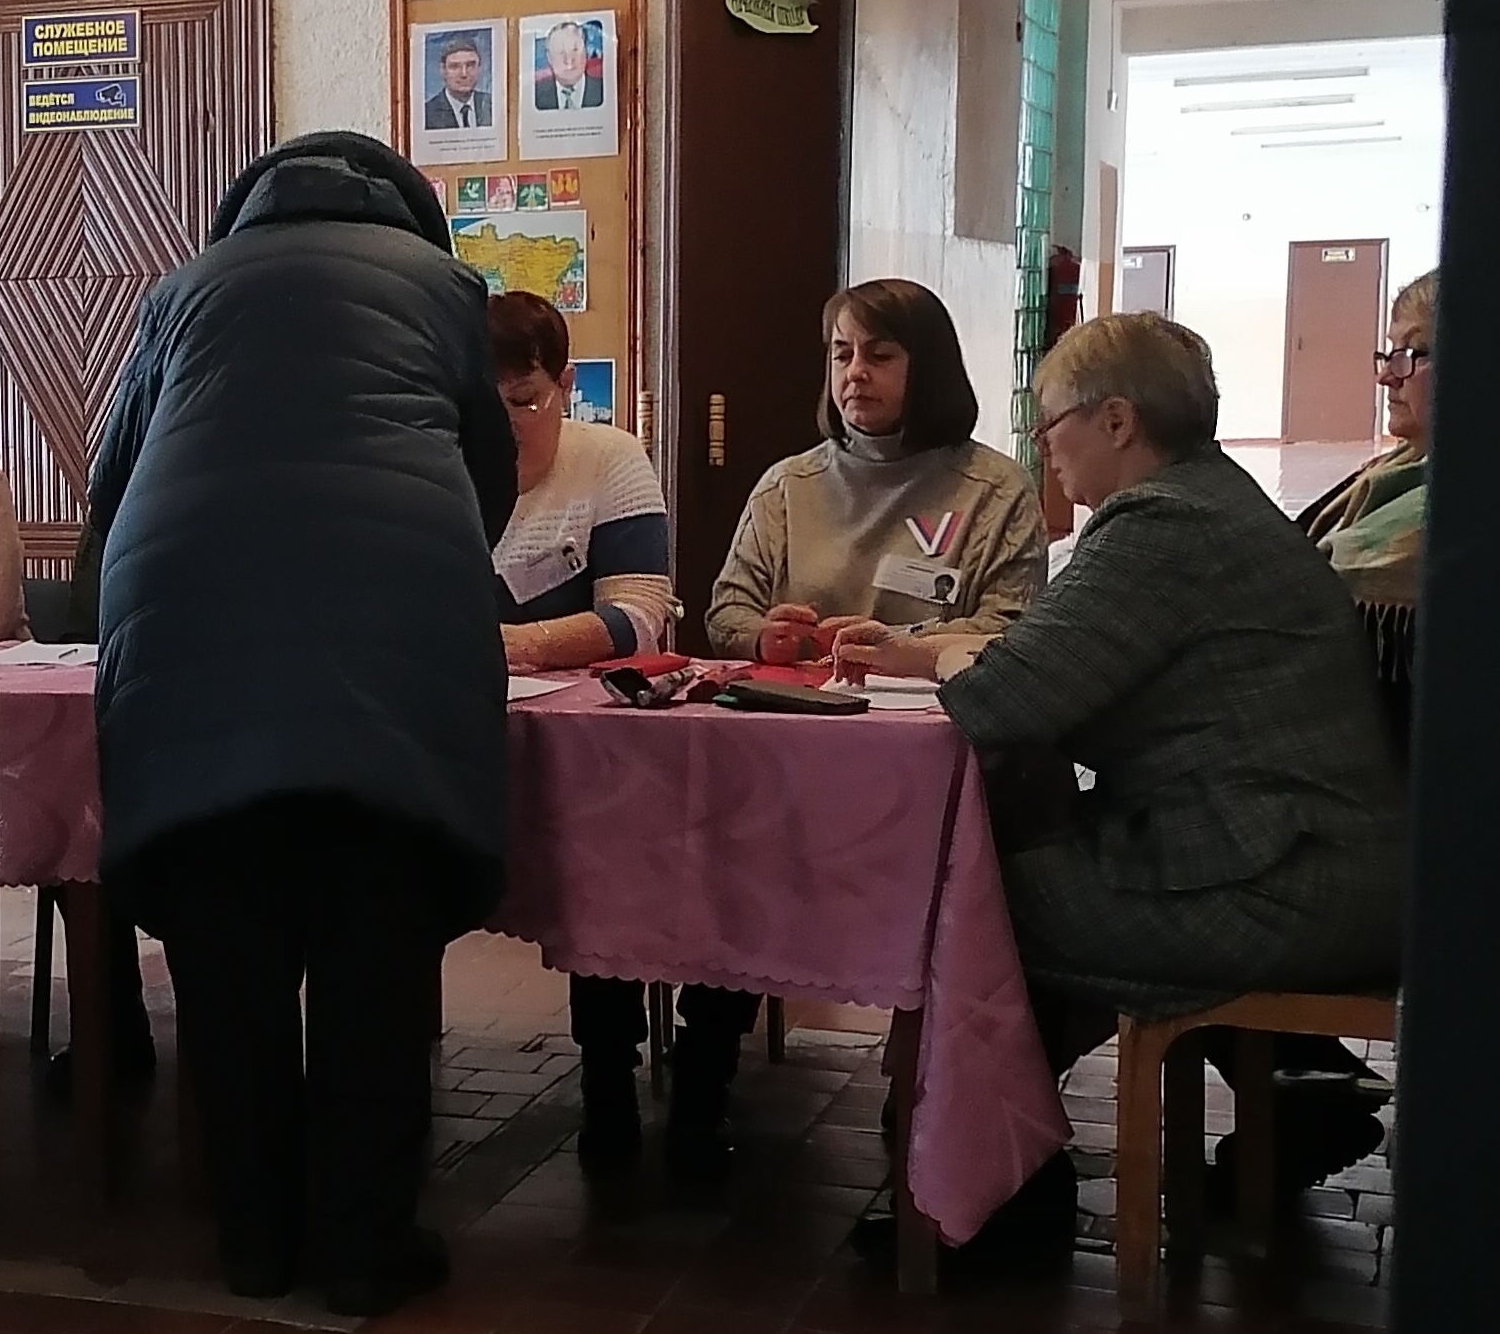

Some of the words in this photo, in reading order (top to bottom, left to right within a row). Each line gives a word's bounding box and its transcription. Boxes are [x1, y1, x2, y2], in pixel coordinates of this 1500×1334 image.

[34, 20, 126, 39] СЛУЖЕБНОЕ
[32, 37, 128, 57] ПОМЕЩЕНИЕ
[28, 108, 135, 125] ВИДЕОНАБЛЮДЕНИЕ
